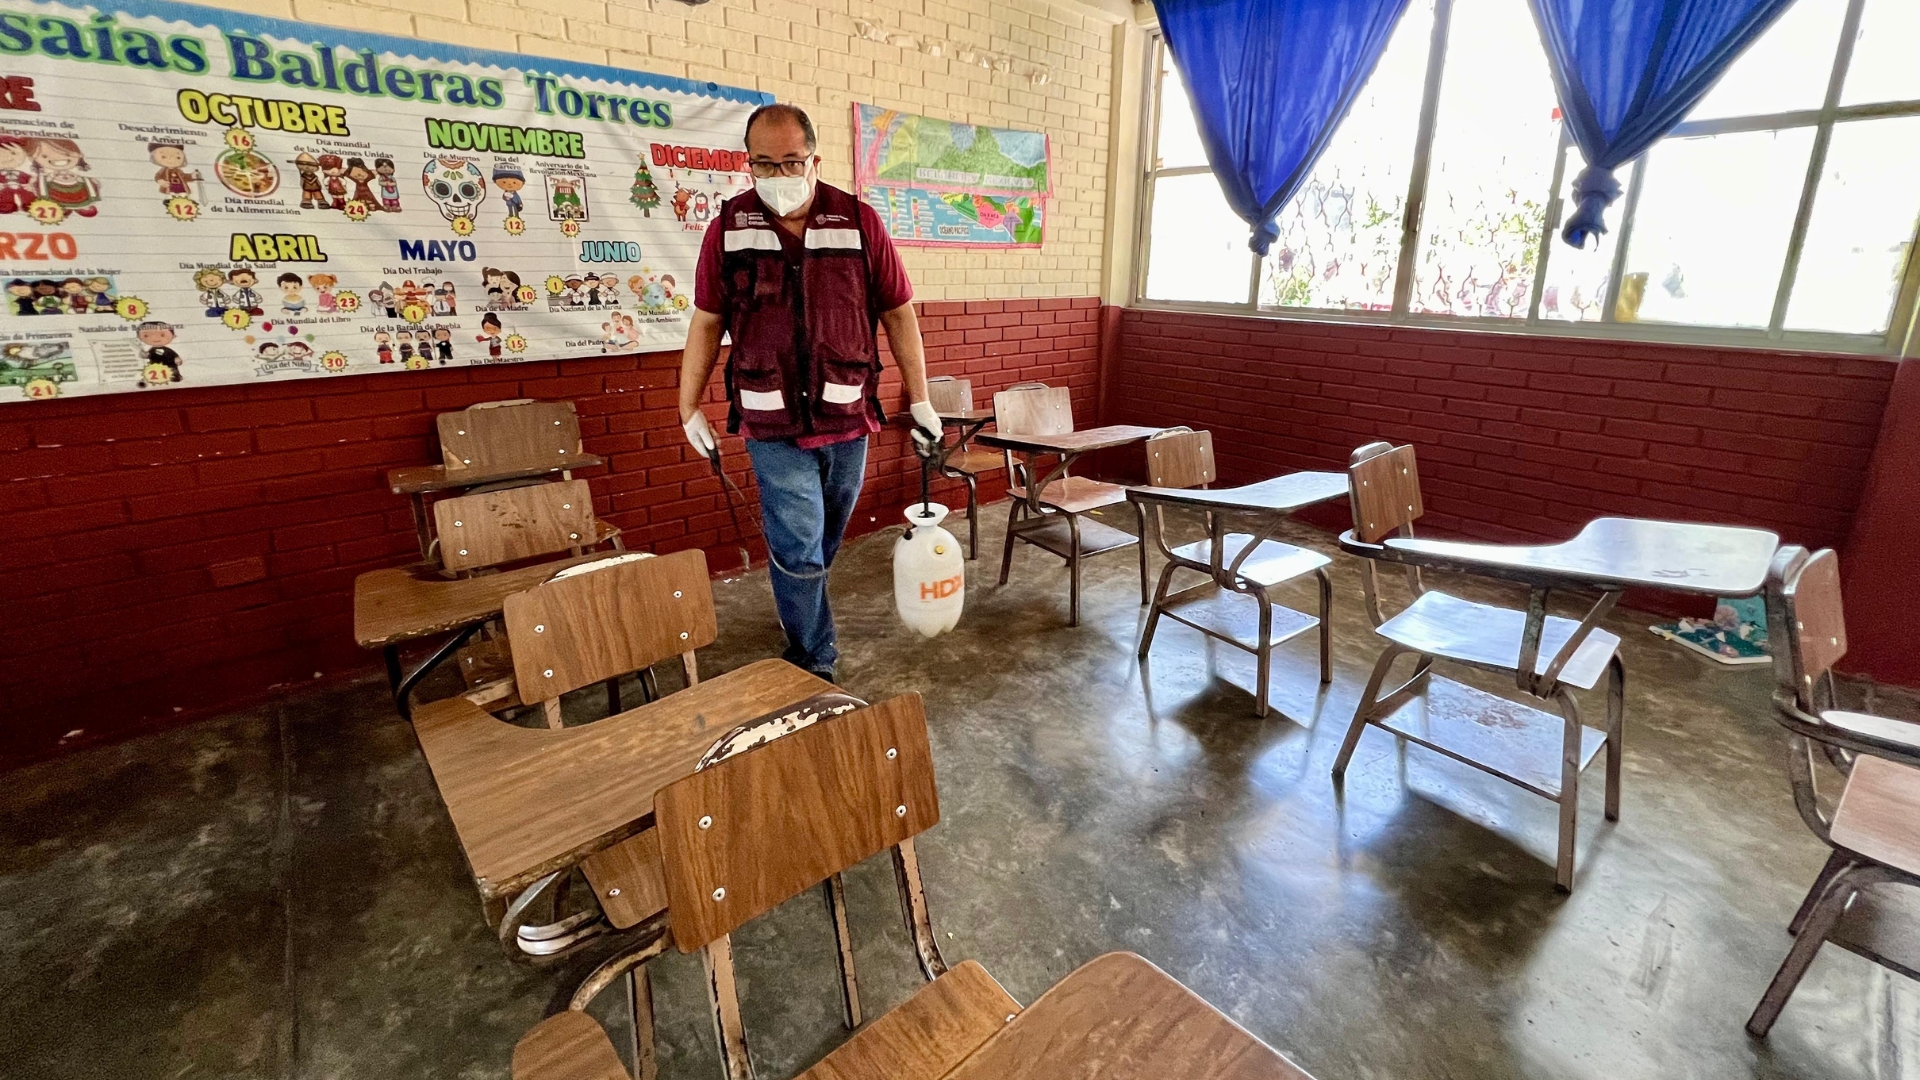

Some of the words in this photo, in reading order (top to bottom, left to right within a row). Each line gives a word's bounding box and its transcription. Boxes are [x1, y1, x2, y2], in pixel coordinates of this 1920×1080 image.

[225, 33, 504, 108] Balderas
[526, 72, 673, 128] Torres
[177, 88, 350, 137] OCTUBRE
[60, 121, 75, 129] de
[118, 123, 208, 137] Descubrimiento
[135, 134, 149, 142] de
[232, 135, 250, 146] 16
[425, 117, 586, 159] NOVIEMBRE
[334, 140, 371, 149] mundial
[322, 147, 362, 157] Naciones
[364, 150, 394, 159] Unidas
[450, 154, 480, 162] Muertos
[535, 161, 574, 169] Aniversario
[244, 198, 284, 206] mundial
[35, 207, 57, 218] 27
[174, 204, 195, 216] 12
[211, 205, 223, 213] de
[225, 205, 234, 213] la
[236, 206, 301, 215] Alimentación
[348, 205, 365, 215] 24
[459, 222, 466, 230] 2
[509, 221, 521, 230] 12
[564, 224, 576, 232] 20
[230, 233, 328, 262] ABRIL
[399, 239, 477, 262] MAYO
[579, 240, 642, 263] JUNIO
[75, 268, 86, 276] de
[88, 268, 96, 276] la
[97, 268, 121, 277] Mujer
[383, 267, 397, 275] Día
[414, 267, 443, 276] Trabajo
[521, 291, 533, 300] 10
[340, 298, 356, 307] 23
[128, 305, 137, 315] 8
[233, 315, 241, 324] 7
[412, 310, 417, 320] 1
[79, 325, 116, 334] Natalicio
[436, 322, 461, 330] Puebla
[511, 339, 523, 349] 15
[292, 360, 310, 368] Niño
[326, 358, 343, 368] 30
[415, 360, 421, 369] 5
[497, 356, 524, 364] Maestro
[148, 369, 168, 380] 21
[32, 386, 52, 396] 21
